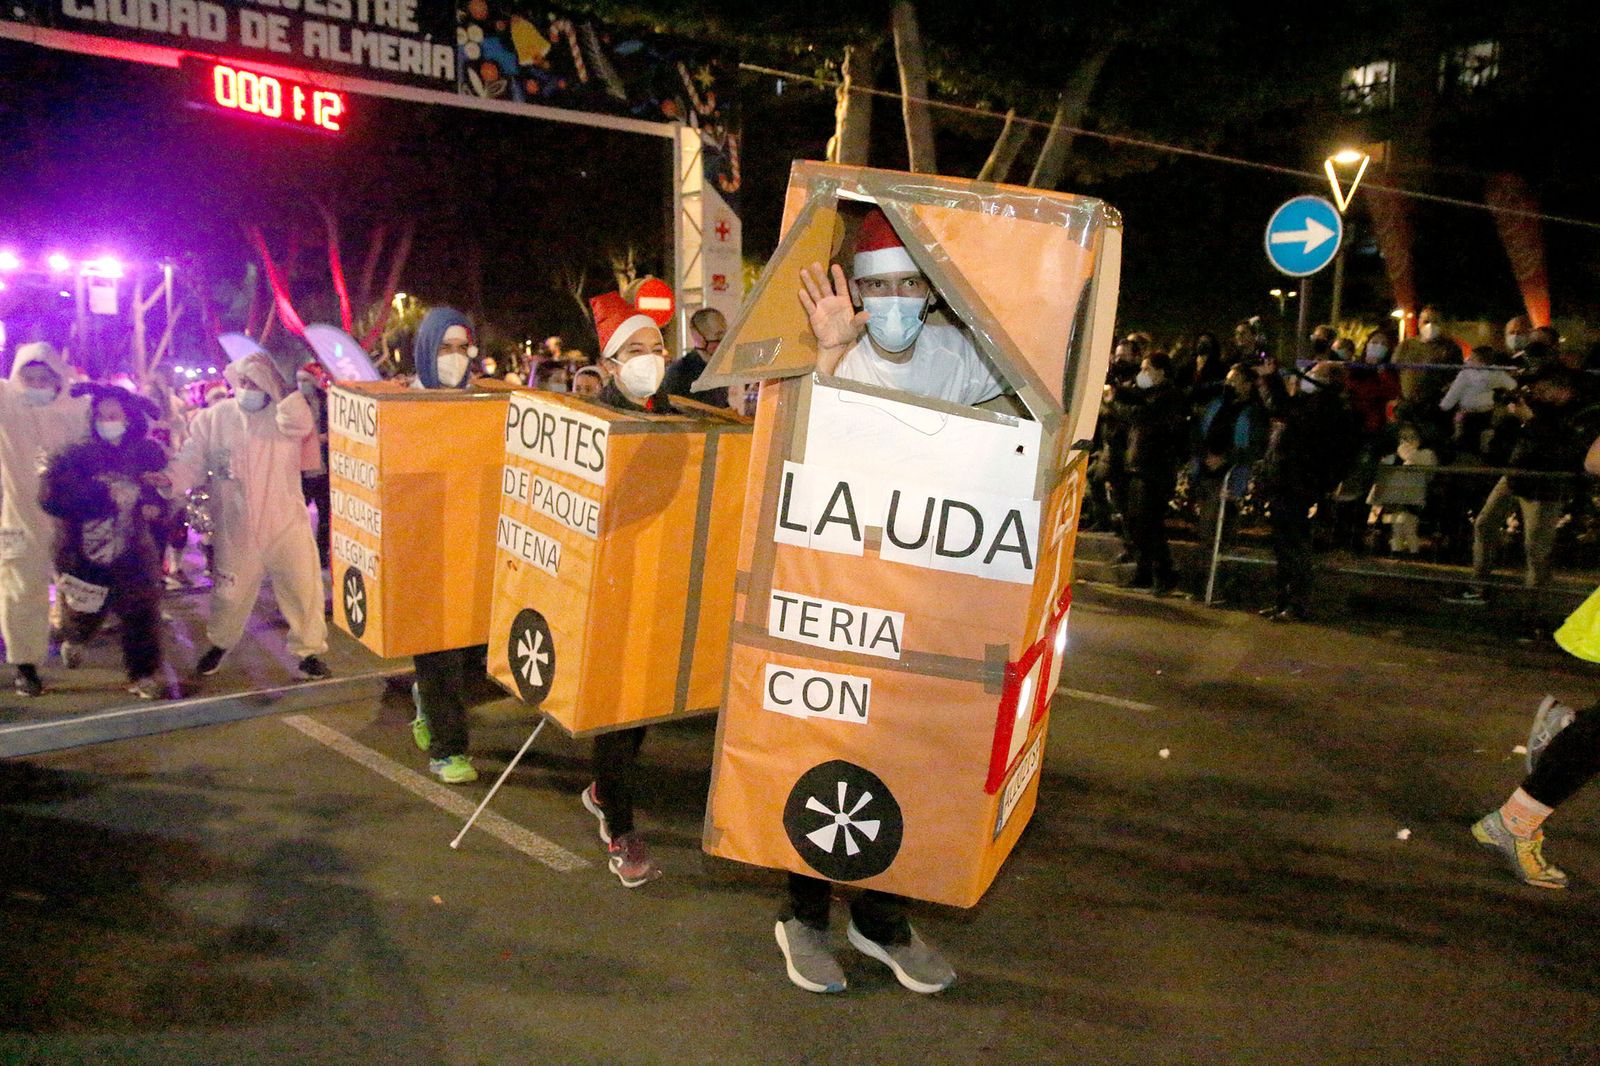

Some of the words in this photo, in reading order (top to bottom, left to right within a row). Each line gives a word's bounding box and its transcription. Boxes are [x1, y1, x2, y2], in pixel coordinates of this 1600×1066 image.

[240, 8, 292, 54] DE
[303, 20, 456, 81] ALMERÍA
[331, 391, 377, 437] TRANS
[506, 402, 606, 473] PORTES
[504, 468, 528, 500] DE
[532, 479, 599, 534] PAQUE
[779, 472, 861, 541] LA
[886, 489, 1033, 570] UDA
[498, 517, 559, 573] NTENA
[773, 594, 900, 654] TERIA
[768, 670, 868, 717] CON
